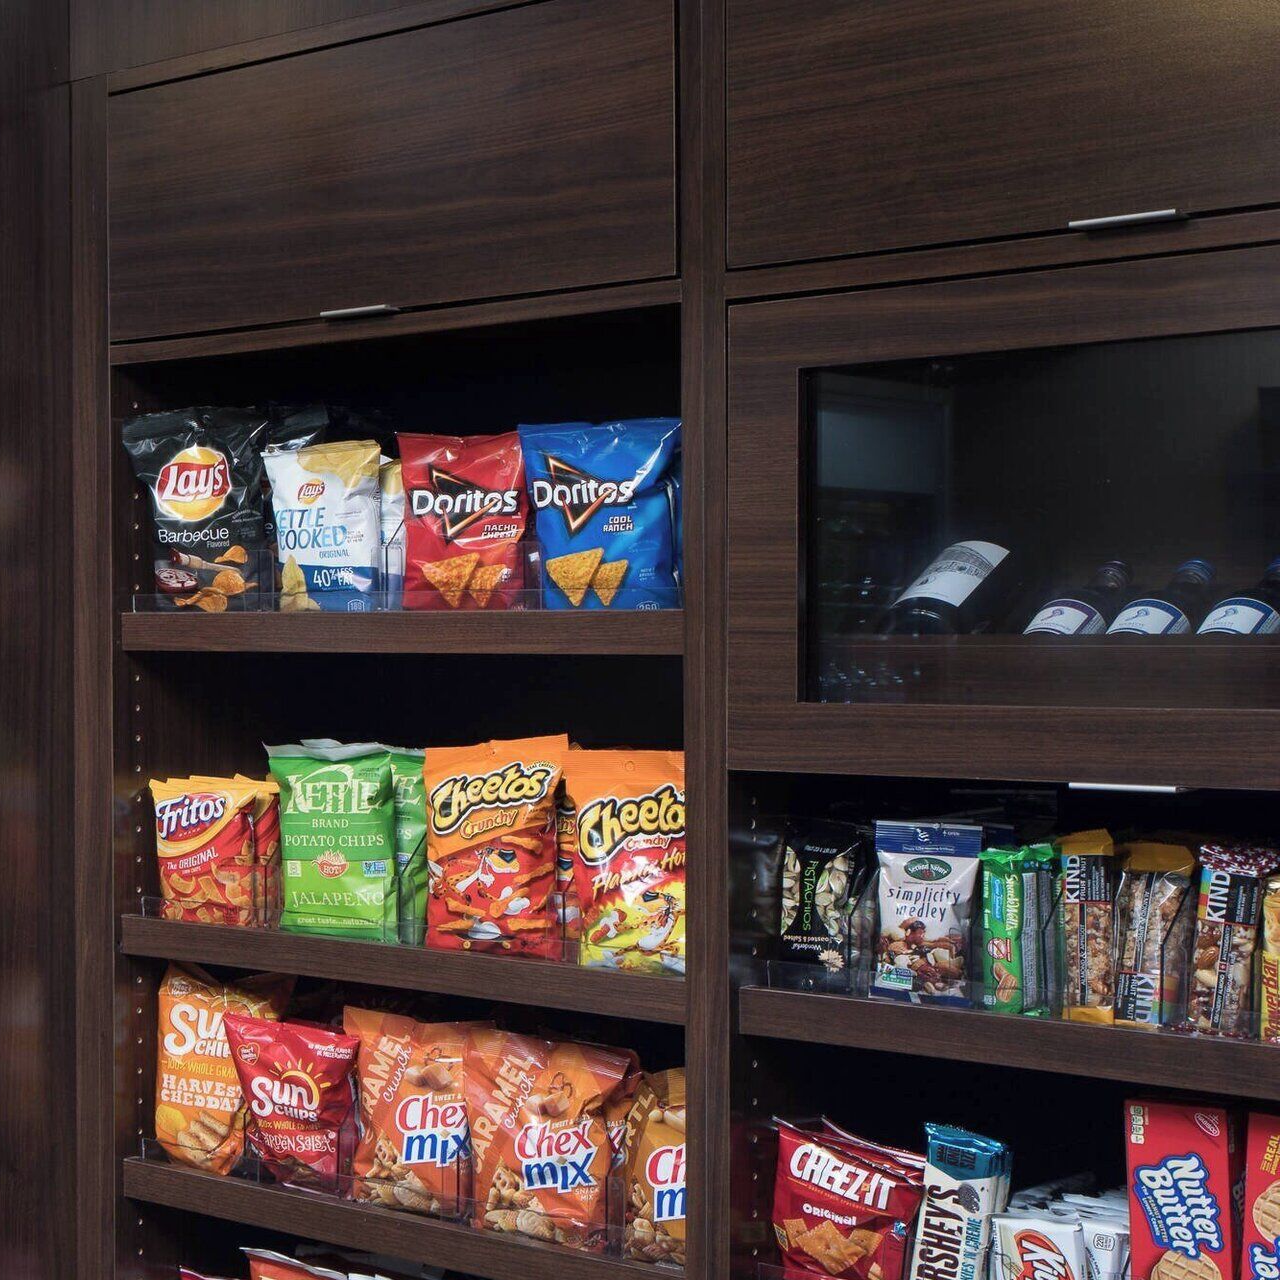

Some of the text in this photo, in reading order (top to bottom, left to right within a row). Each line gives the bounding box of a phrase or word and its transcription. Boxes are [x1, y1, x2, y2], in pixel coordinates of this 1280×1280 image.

[160, 461, 225, 503] Lay's
[300, 482, 326, 498] Lay's
[533, 480, 633, 509] Doritos
[412, 489, 519, 516] Doritos
[483, 523, 518, 532] NACHO
[603, 523, 634, 533] RANCH
[608, 515, 633, 524] COOL
[158, 527, 230, 544] Barbecue
[206, 540, 230, 549] Flavored
[279, 525, 348, 550] COOKED
[319, 549, 350, 559] ORIGINAL
[284, 774, 382, 816] KETTLE
[432, 763, 552, 834] Cheetos
[155, 794, 227, 840] Fritos
[312, 818, 349, 829] BRAND
[460, 808, 519, 839] Crunchy
[578, 786, 685, 863] Cheeto
[285, 834, 385, 847] POTATO CHIPS
[167, 848, 219, 871] The ORIGINAL
[323, 866, 341, 875] HOT
[1064, 854, 1080, 904] KIND
[802, 859, 819, 932] PISTACHIOS
[886, 885, 962, 904] simplicity
[1207, 870, 1231, 922] KIND
[895, 903, 947, 921] medley
[1137, 973, 1155, 1023] KIND
[1263, 958, 1278, 1038] PowerBar
[382, 1045, 413, 1103] crunch
[250, 1075, 320, 1117] Sun
[273, 1104, 318, 1121] CHIPS
[404, 1130, 471, 1166] mix
[515, 1119, 594, 1161] Chex
[525, 1151, 596, 1192] mix
[575, 1186, 600, 1196] SNACK
[1164, 1155, 1219, 1253] Nutter
[1139, 1168, 1198, 1261] Butter
